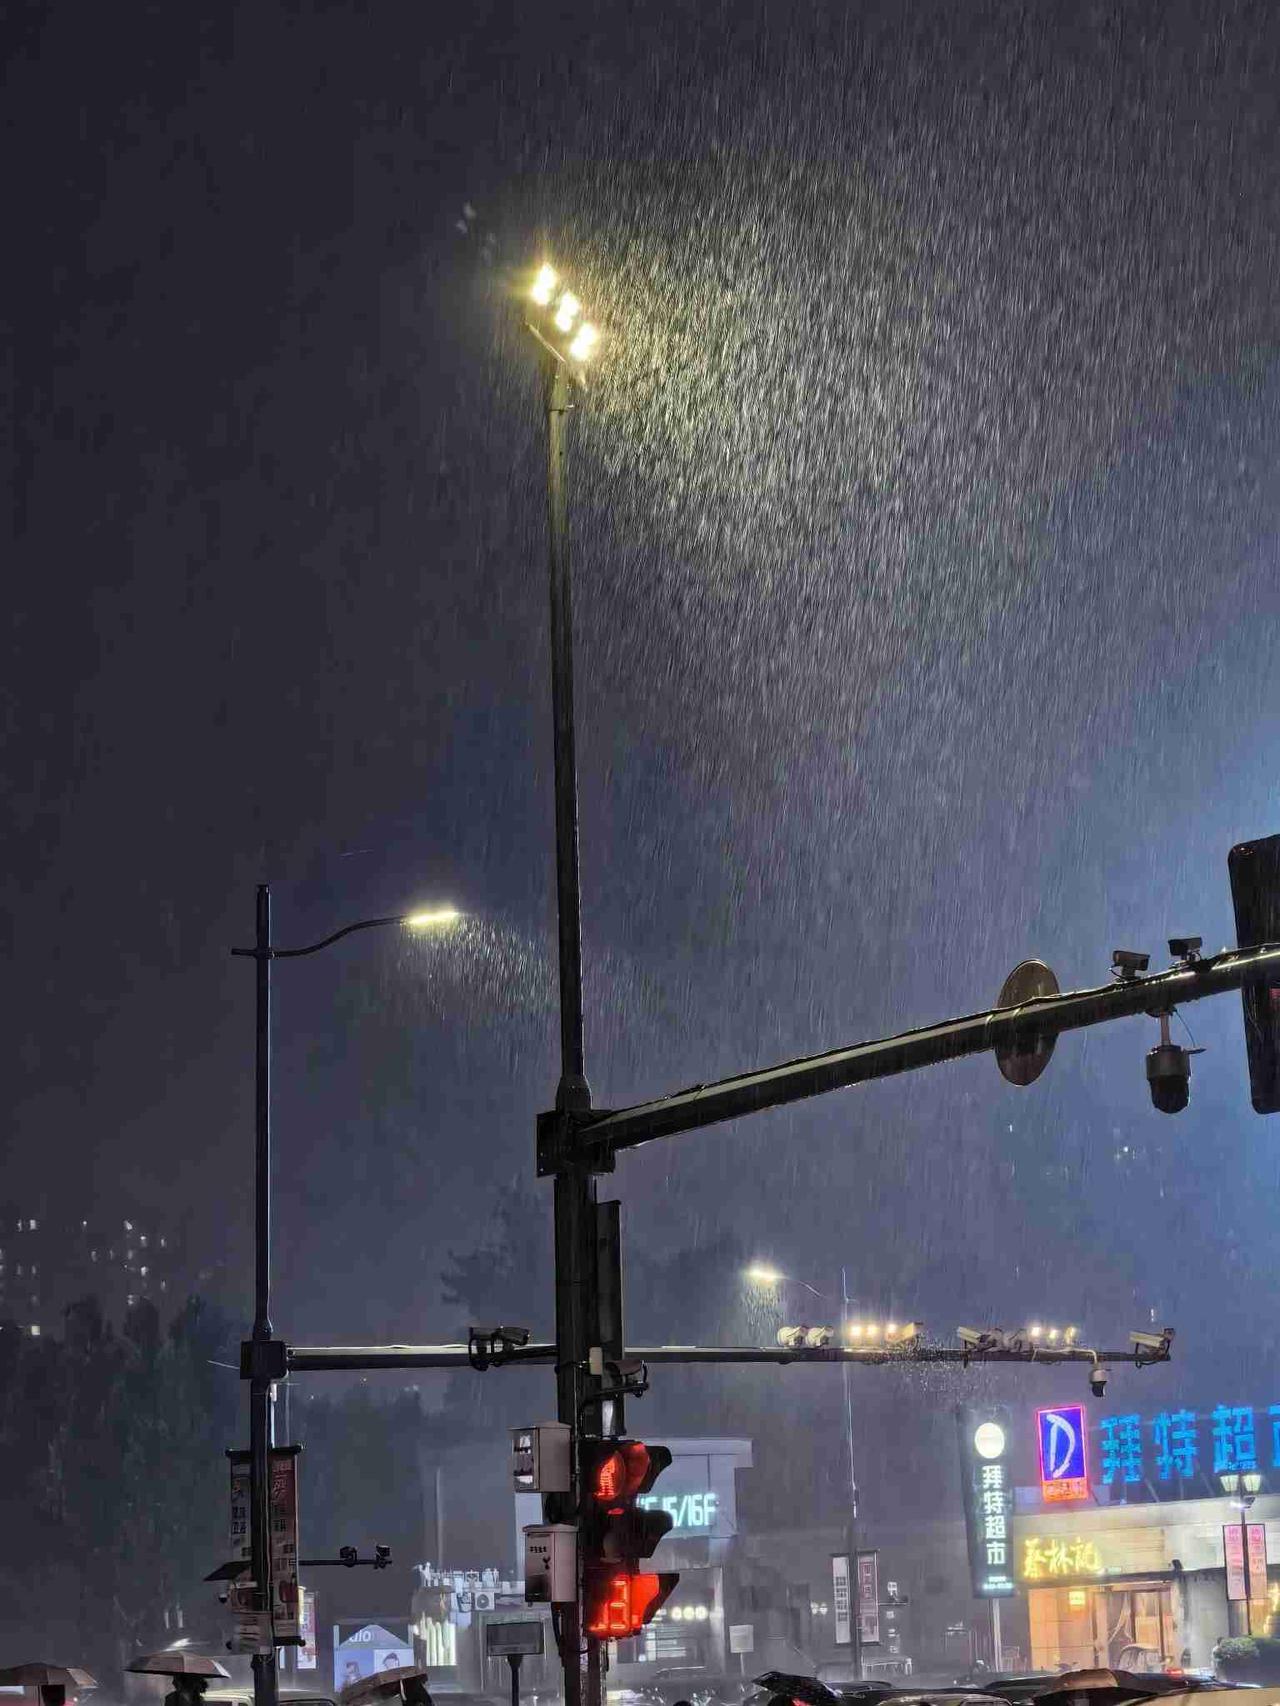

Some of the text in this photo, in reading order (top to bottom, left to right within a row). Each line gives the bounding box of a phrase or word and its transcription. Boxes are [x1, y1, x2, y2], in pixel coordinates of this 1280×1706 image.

[1100, 1403, 1280, 1484] 拜特超
[982, 1465, 1006, 1564] 拜特超市
